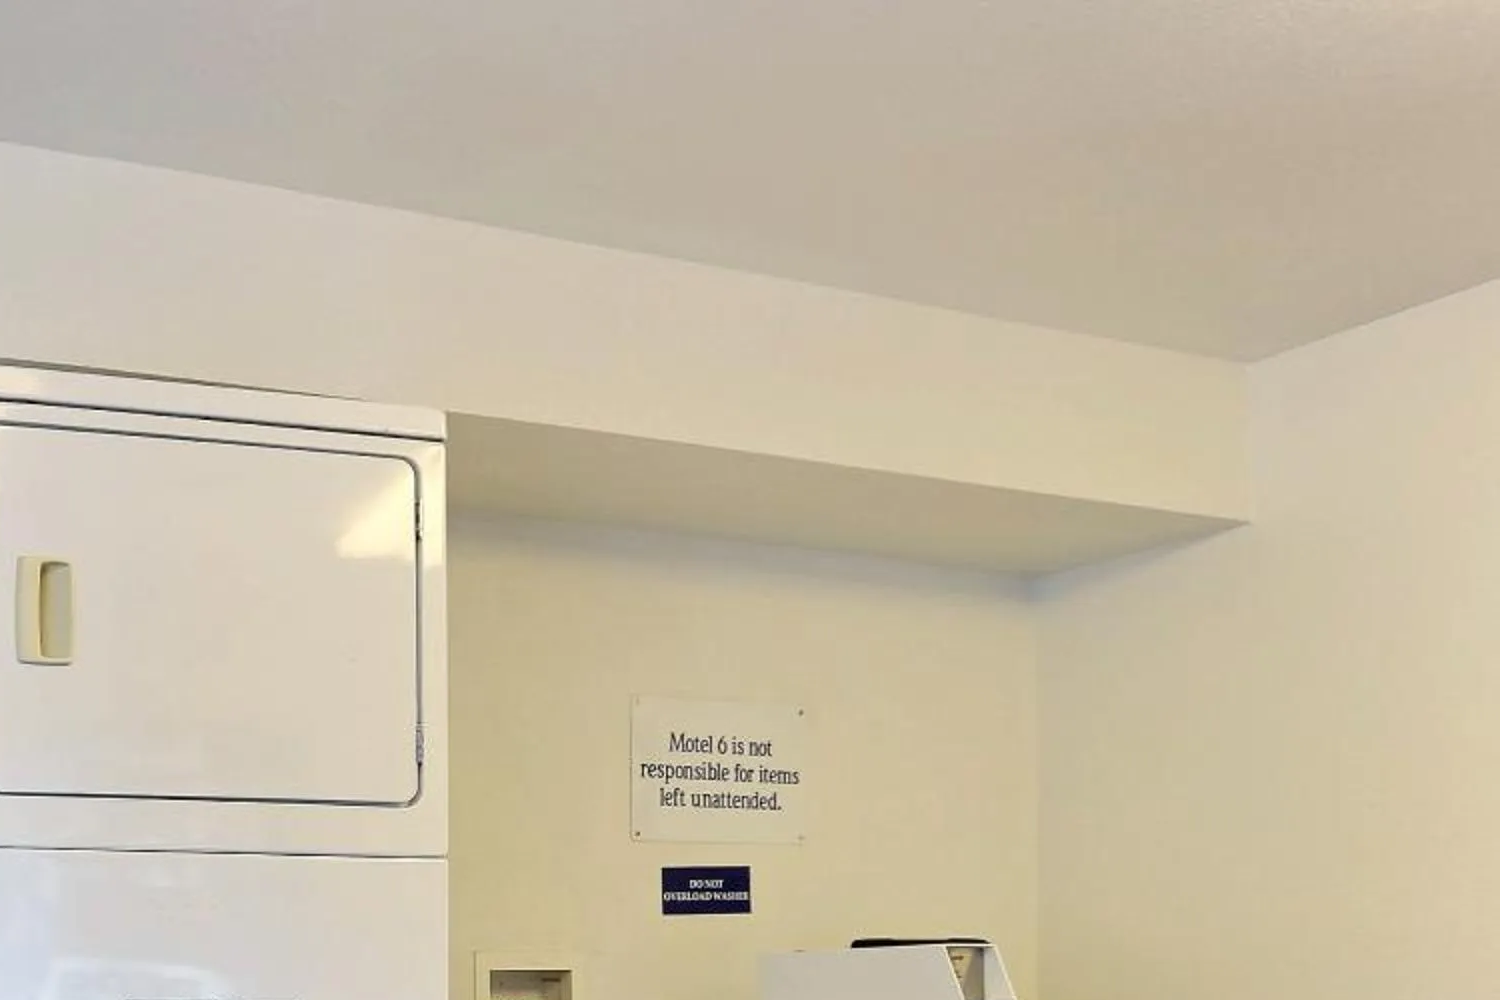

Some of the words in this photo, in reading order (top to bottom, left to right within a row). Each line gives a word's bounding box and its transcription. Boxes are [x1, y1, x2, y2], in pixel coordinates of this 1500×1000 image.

[669, 732, 713, 754] Motel
[717, 736, 728, 755] 6
[732, 736, 745, 756] is
[749, 741, 773, 757] not
[640, 761, 730, 784] responsible
[734, 763, 754, 783] for
[759, 765, 800, 785] items
[659, 788, 686, 807] left
[691, 792, 782, 811] unattended.
[689, 880, 703, 889] DO
[704, 879, 724, 889] NOT
[663, 891, 712, 901] OVERLOAD
